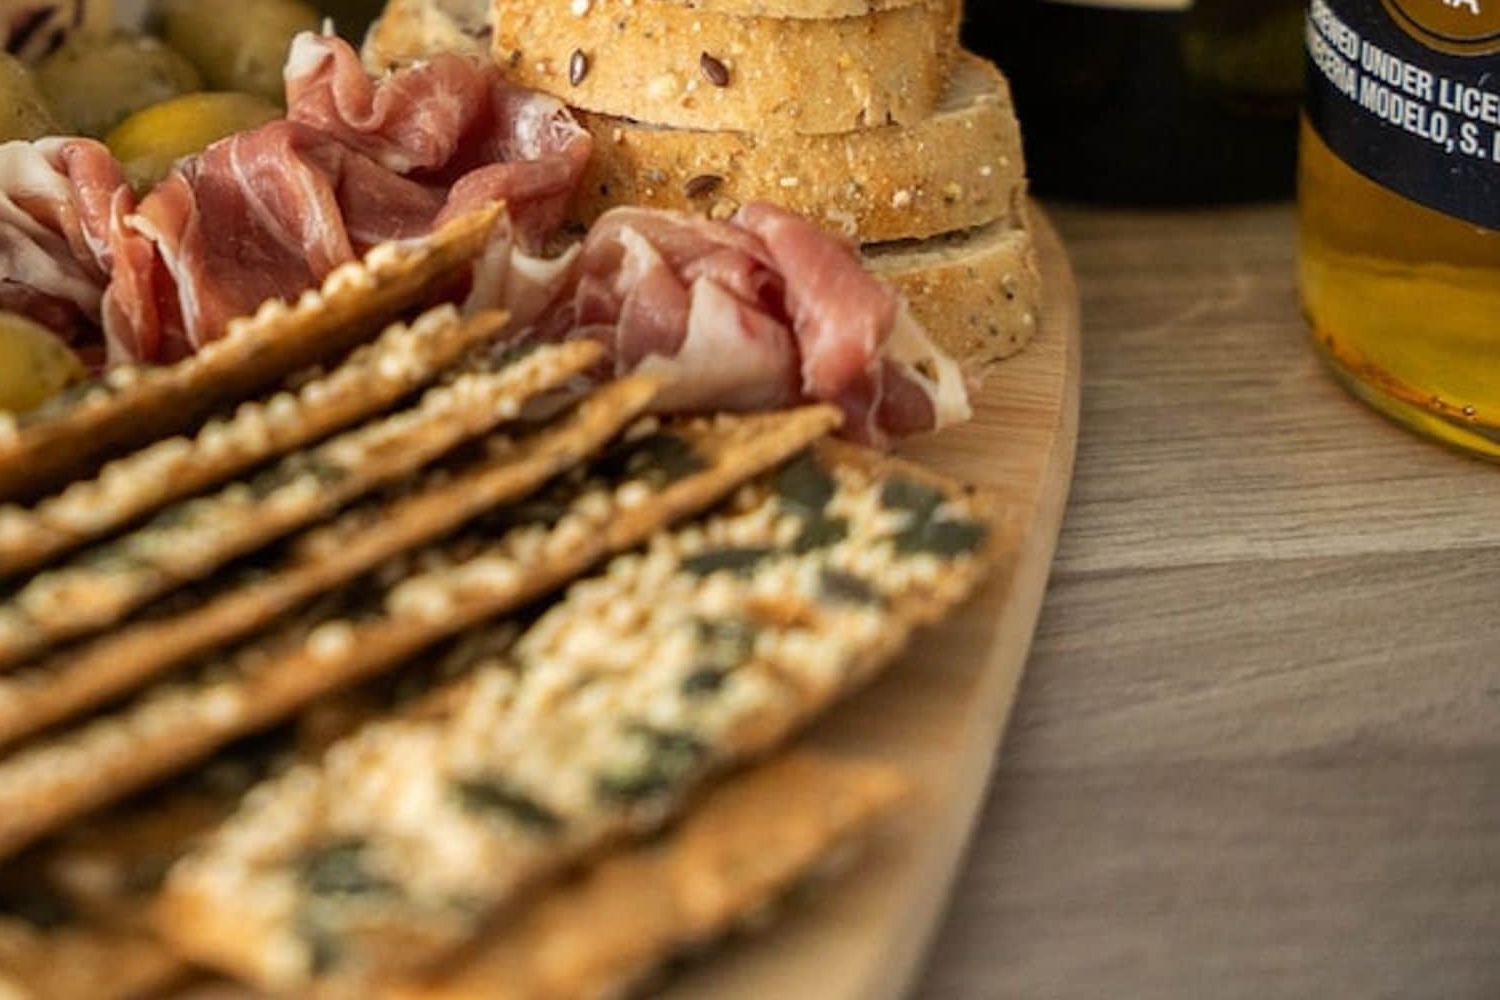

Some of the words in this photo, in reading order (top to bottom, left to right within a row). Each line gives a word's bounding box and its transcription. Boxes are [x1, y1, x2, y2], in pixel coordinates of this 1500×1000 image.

[1359, 75, 1454, 153] MODELO,
[1459, 121, 1487, 158] S.
[1360, 39, 1434, 103] UNDER
[1438, 76, 1500, 128] LICE
